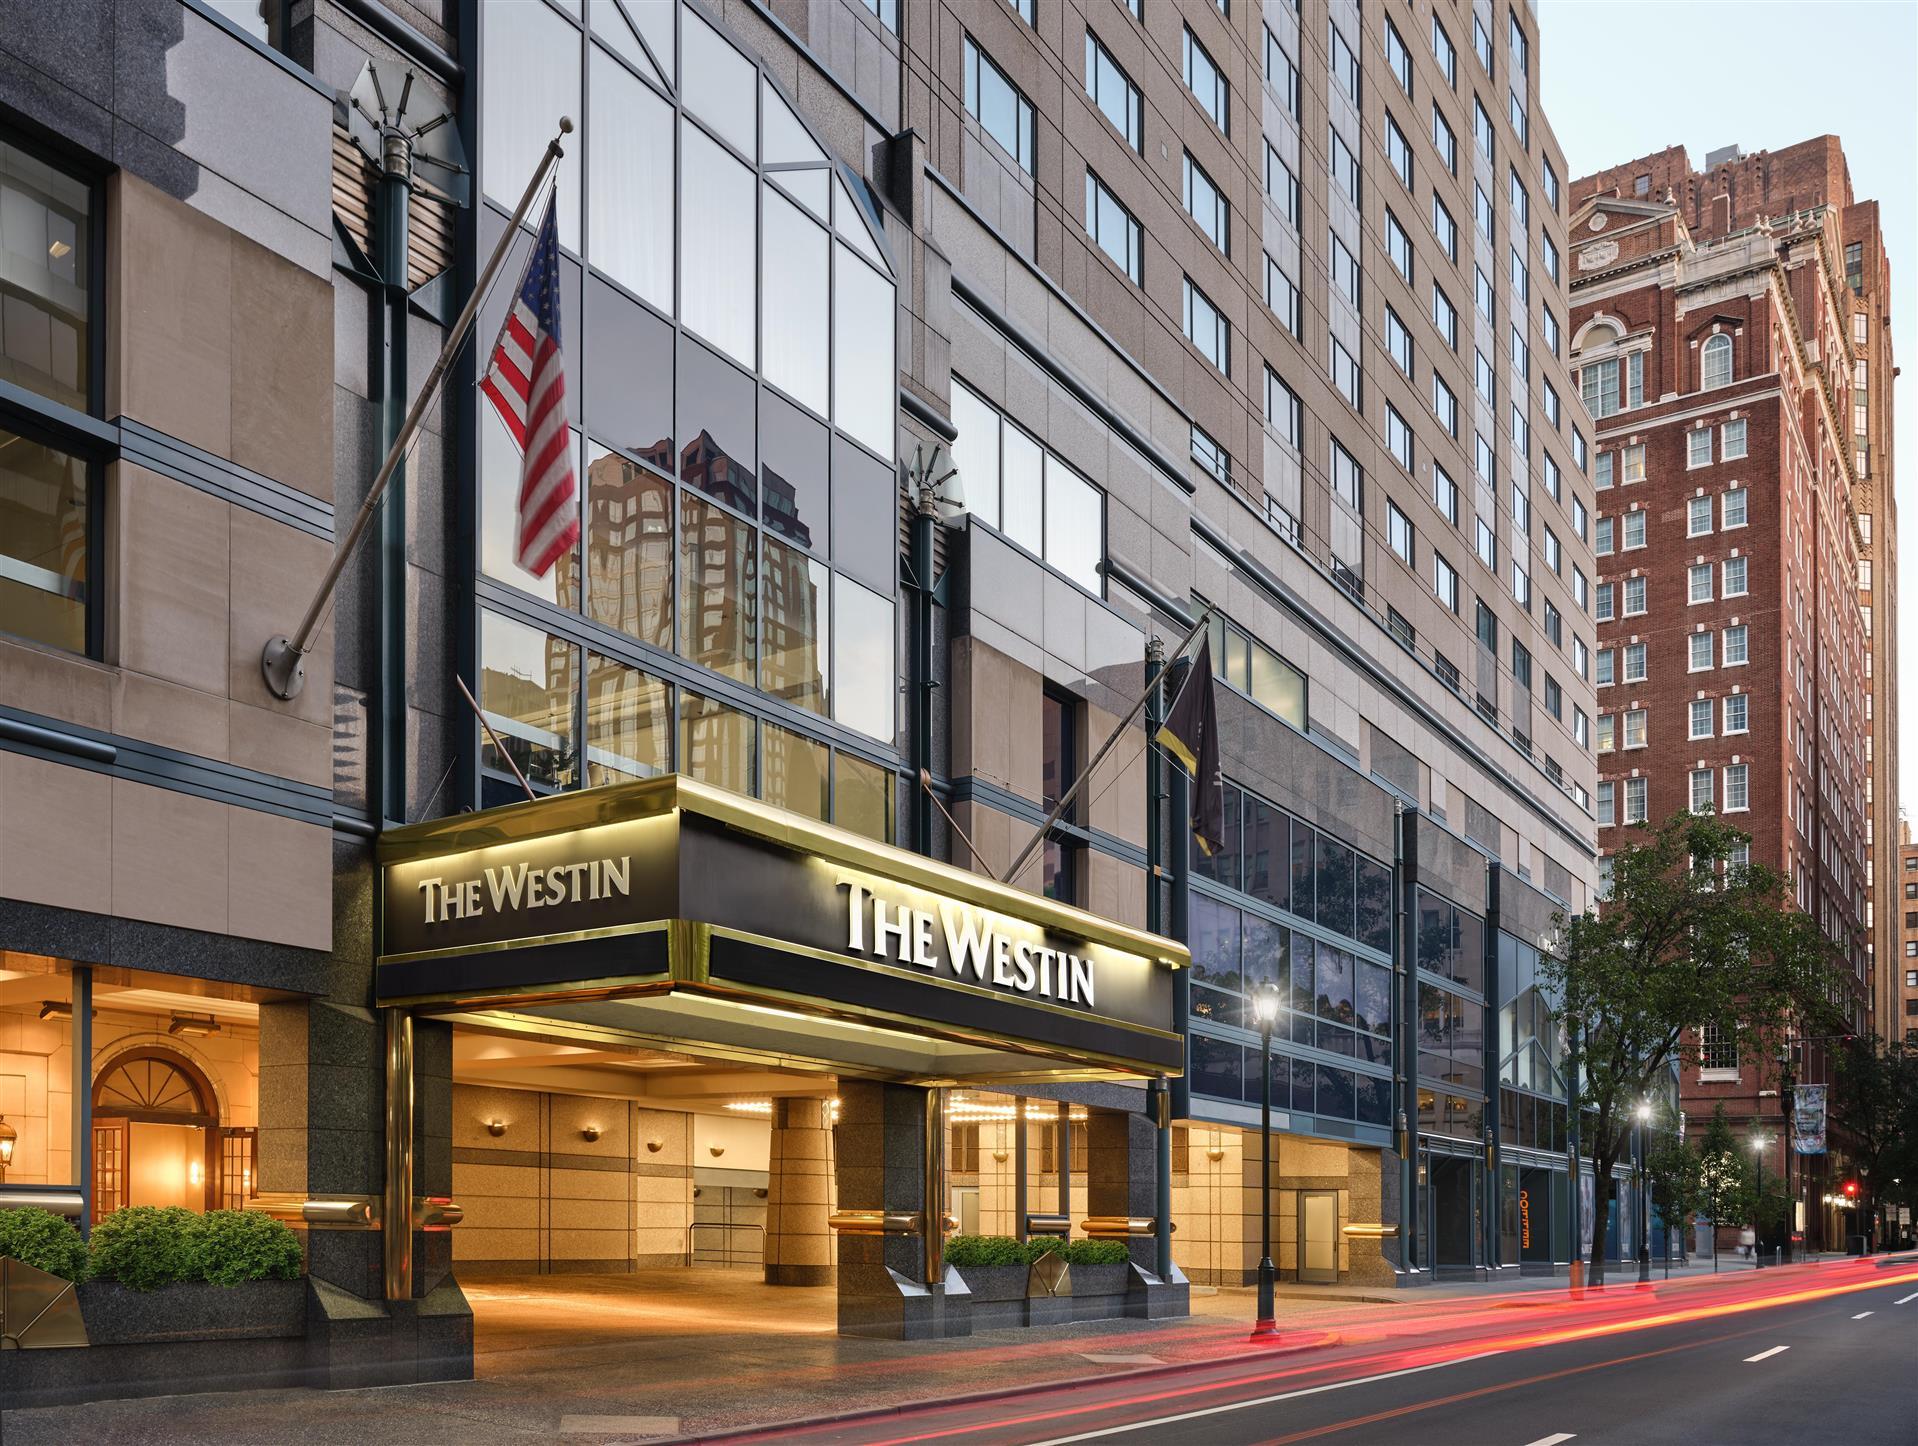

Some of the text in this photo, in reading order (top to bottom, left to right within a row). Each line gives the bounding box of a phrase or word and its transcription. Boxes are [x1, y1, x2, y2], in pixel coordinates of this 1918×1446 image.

[418, 856, 631, 923] THE WESTIN
[835, 873, 1095, 1007] THE WESTIN
